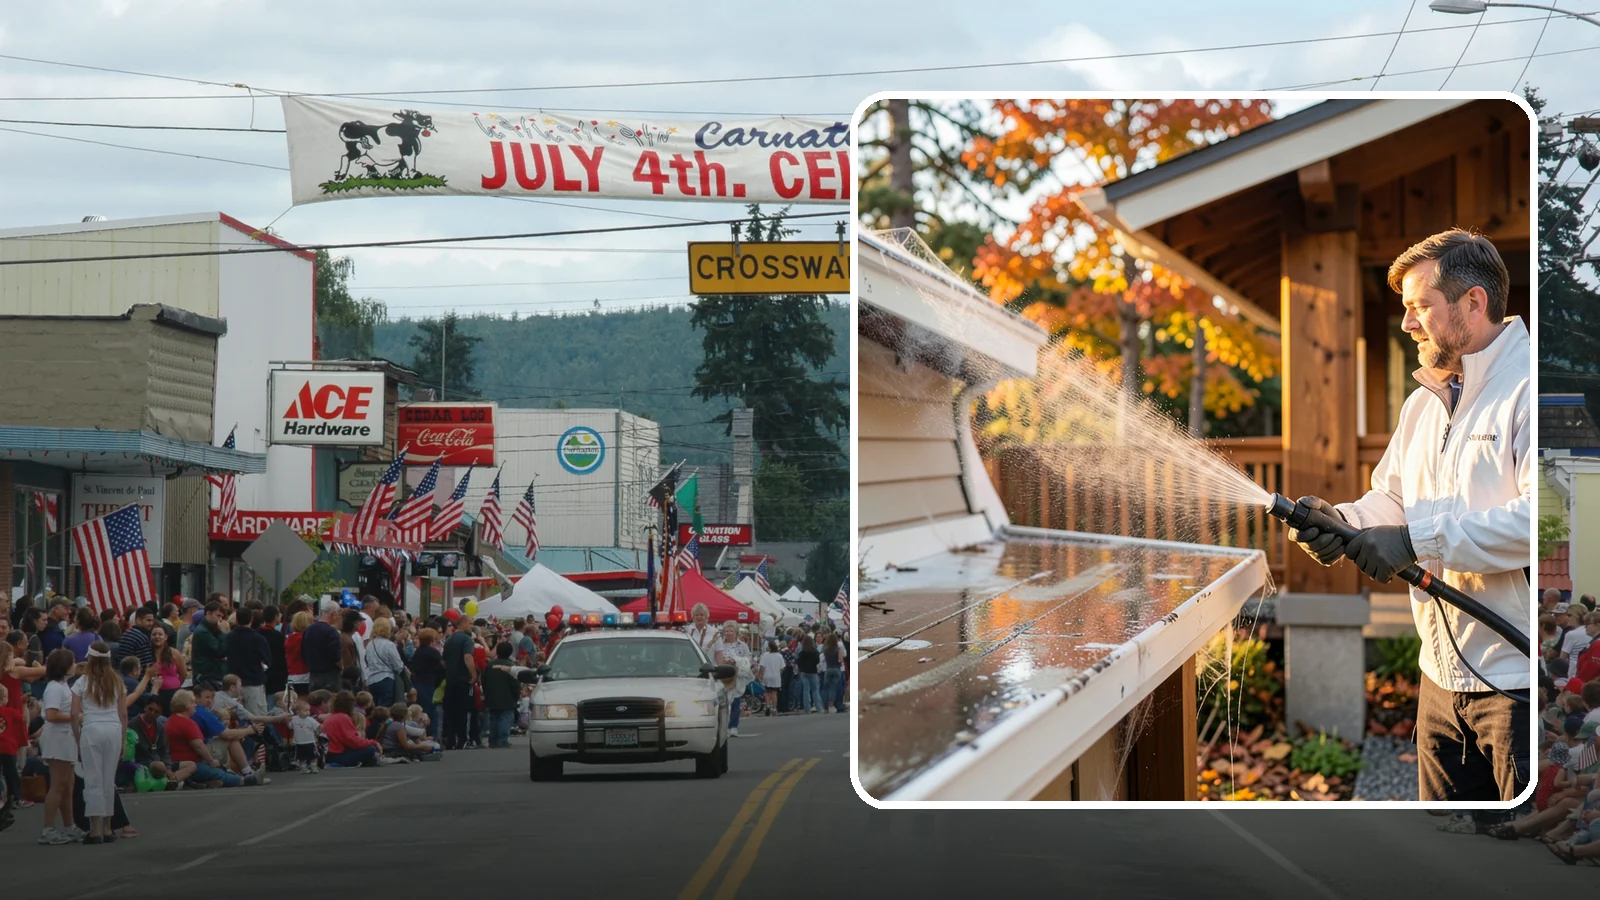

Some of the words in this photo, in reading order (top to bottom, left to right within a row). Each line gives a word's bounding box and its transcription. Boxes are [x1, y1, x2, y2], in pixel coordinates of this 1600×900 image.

[694, 121, 850, 150] Carnat
[481, 141, 605, 193] JULY
[632, 150, 746, 196] 4th.
[697, 254, 850, 280] CROSSWA
[283, 380, 373, 420] ACE
[406, 409, 452, 422] CEDAR
[283, 421, 371, 436] Hardware
[416, 428, 477, 447] Coca-Cola
[353, 467, 385, 480] Simpl
[83, 485, 94, 495] St.
[96, 485, 124, 495] Vincent
[126, 486, 136, 495] de
[137, 486, 155, 495] Paul
[688, 526, 741, 535] CRNATION
[699, 535, 730, 543] GLASS
